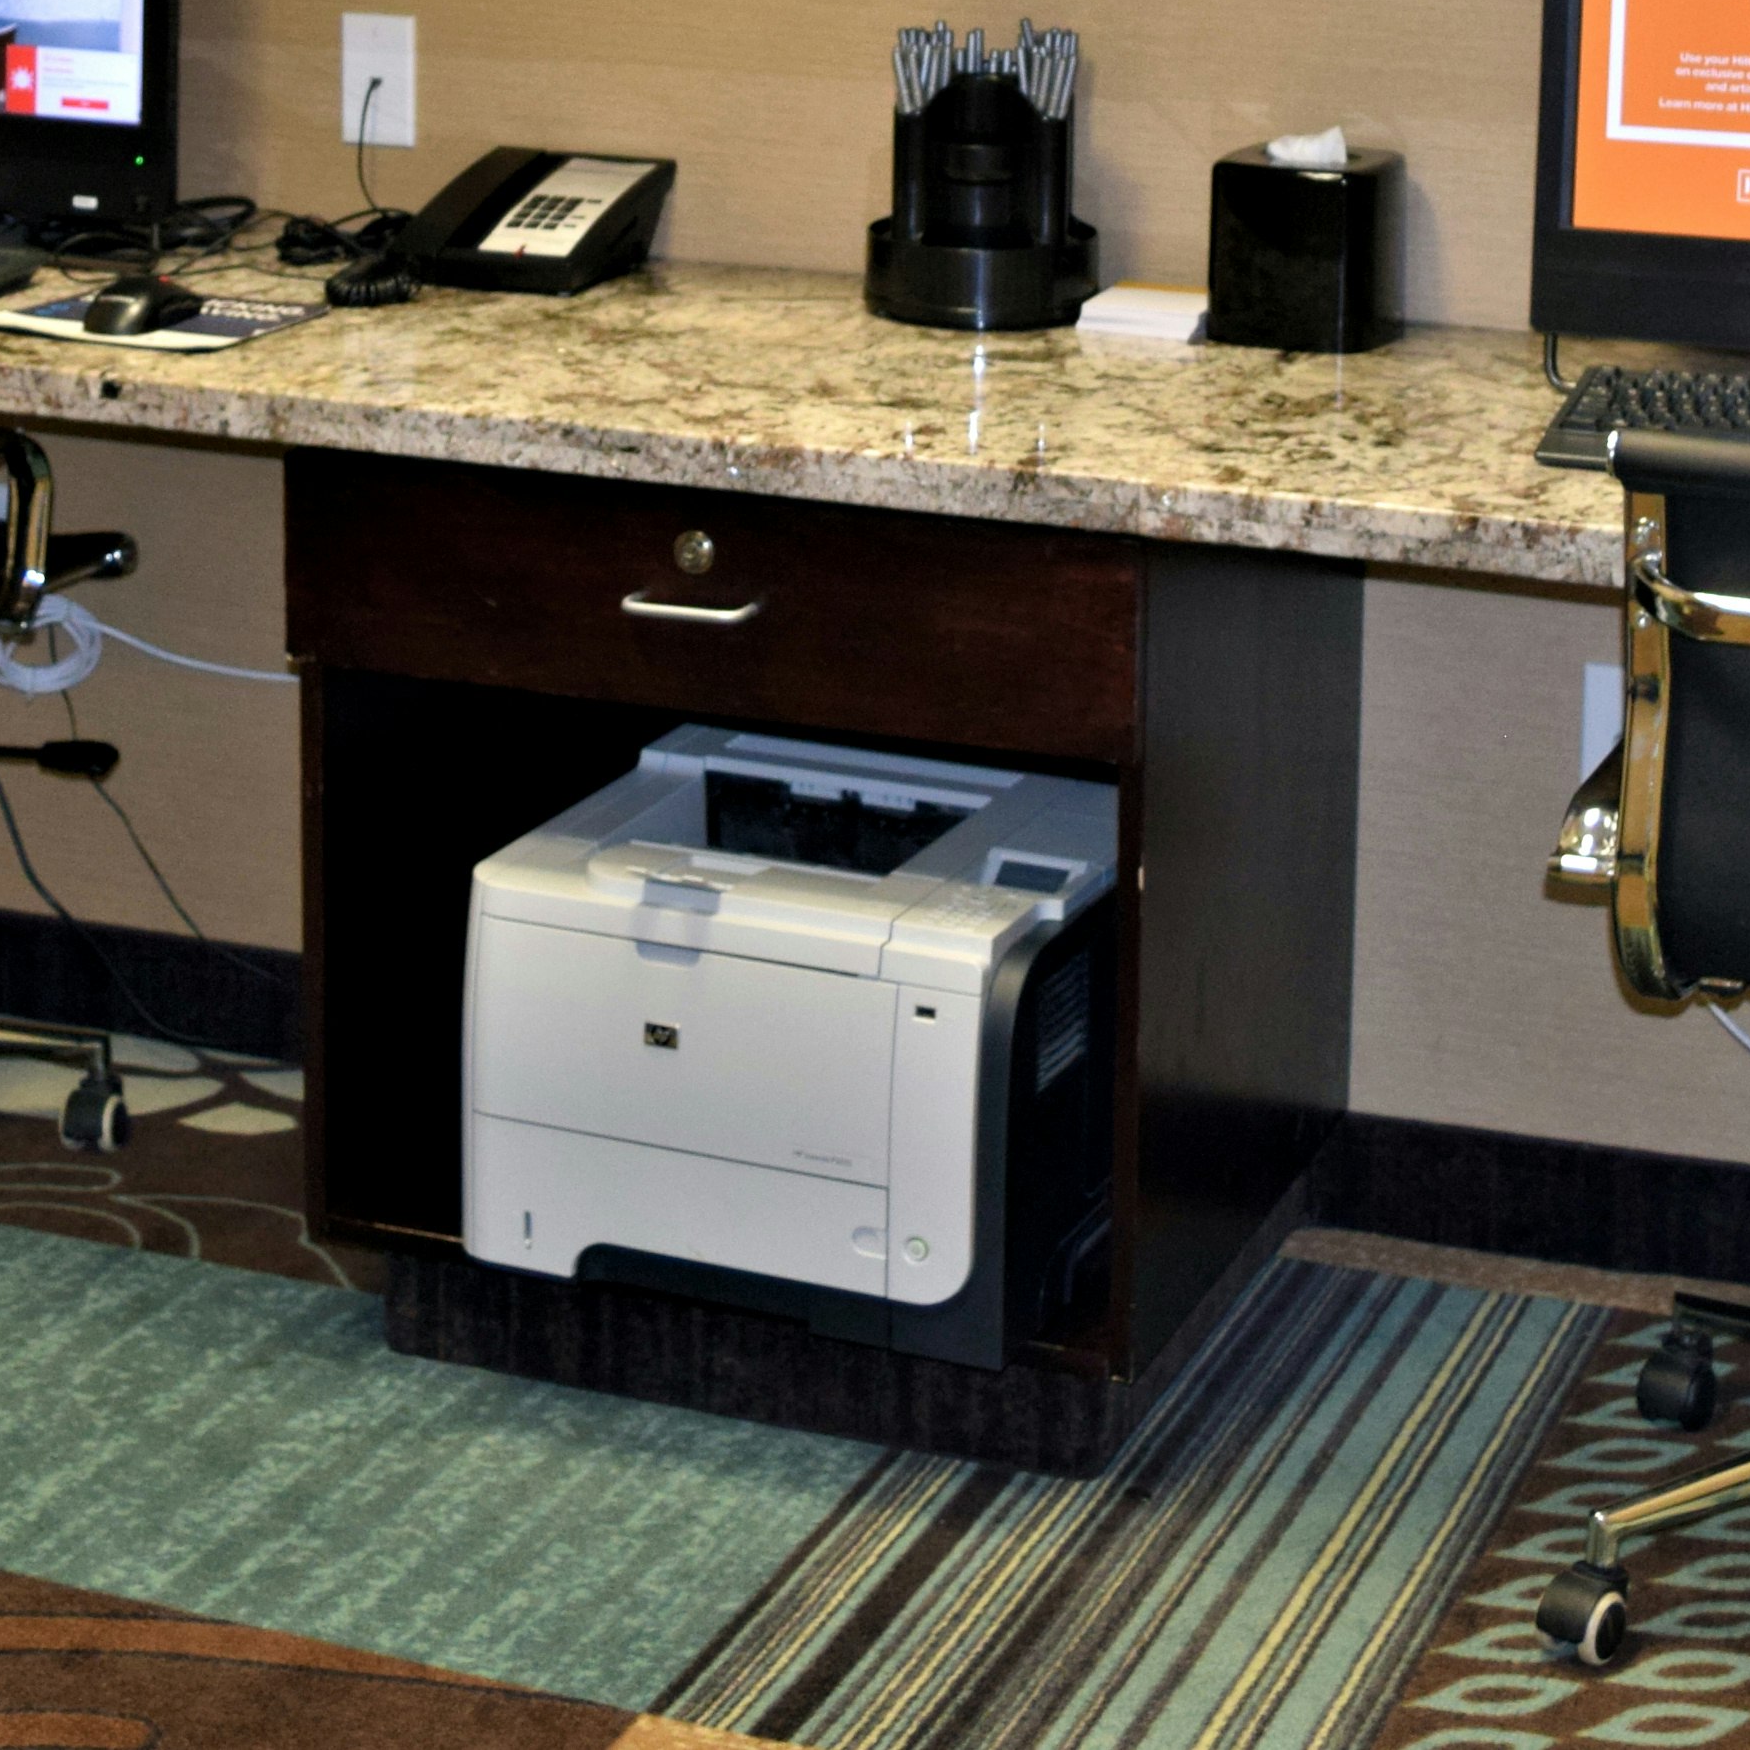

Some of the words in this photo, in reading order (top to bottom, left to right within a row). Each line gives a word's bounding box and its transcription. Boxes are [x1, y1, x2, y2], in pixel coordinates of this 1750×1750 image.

[1680, 52, 1701, 64] Use
[1704, 55, 1729, 67] your
[1675, 66, 1690, 77] on
[1692, 66, 1744, 80] exclusive
[1705, 81, 1726, 92] and
[1659, 97, 1691, 109] Learn
[1694, 101, 1723, 111] more
[1725, 102, 1738, 113] at
